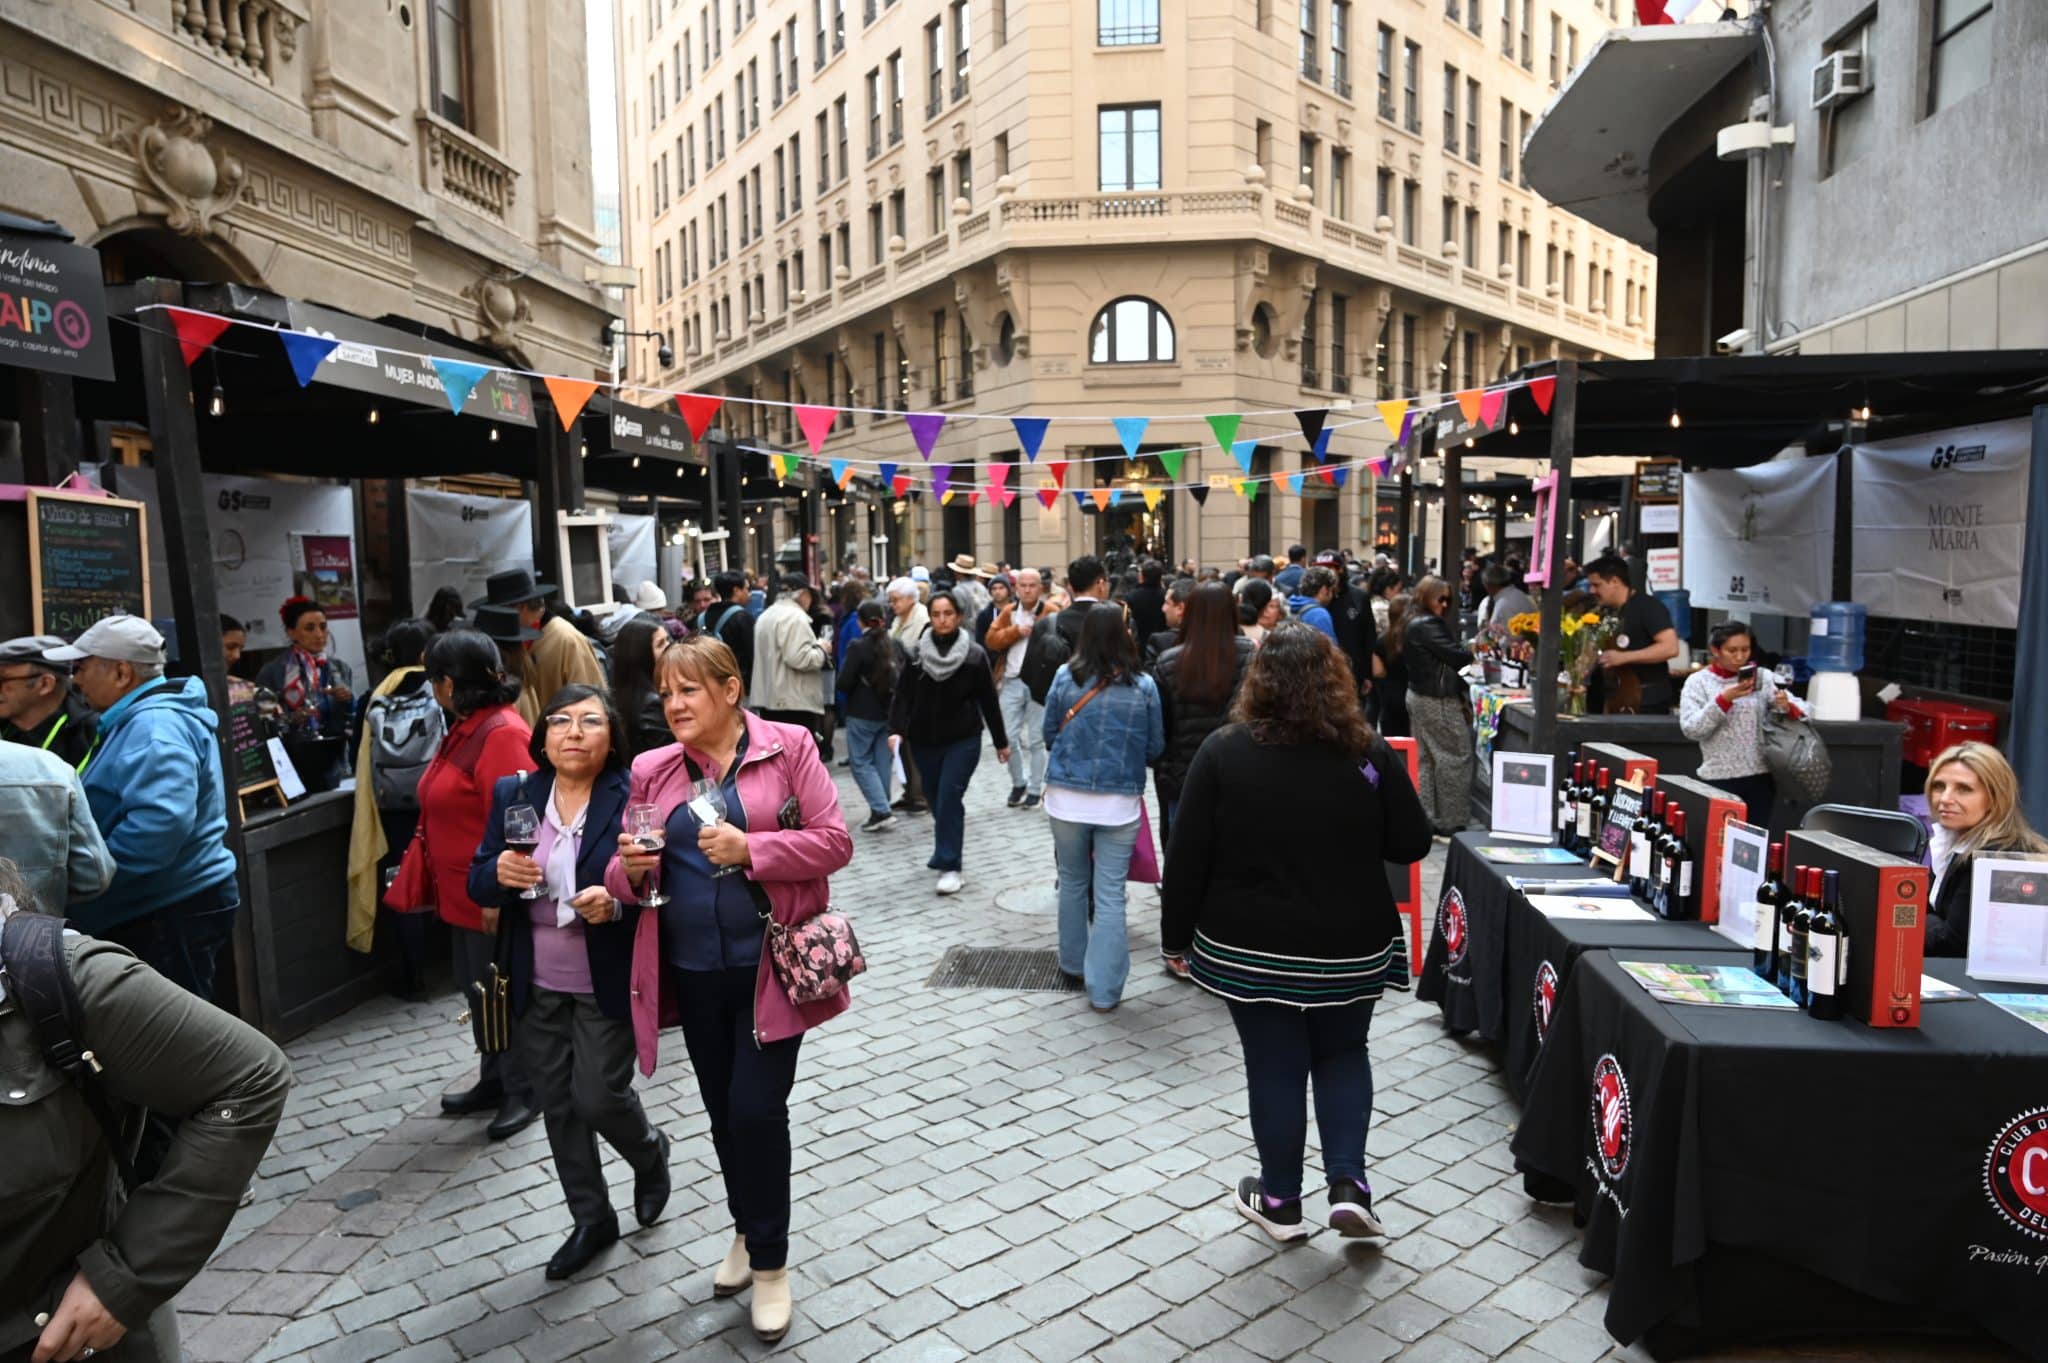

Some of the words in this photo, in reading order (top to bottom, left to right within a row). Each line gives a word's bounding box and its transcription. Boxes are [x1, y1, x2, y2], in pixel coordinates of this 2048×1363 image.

[0, 248, 60, 275] ndimia
[385, 363, 415, 386] MUJER
[416, 372, 447, 393] ANDIN
[1928, 503, 1984, 529] MONTE
[1928, 527, 1979, 552] MARIA
[2000, 1125, 2032, 1157] CLUB
[1968, 1244, 2031, 1266] Pasión
